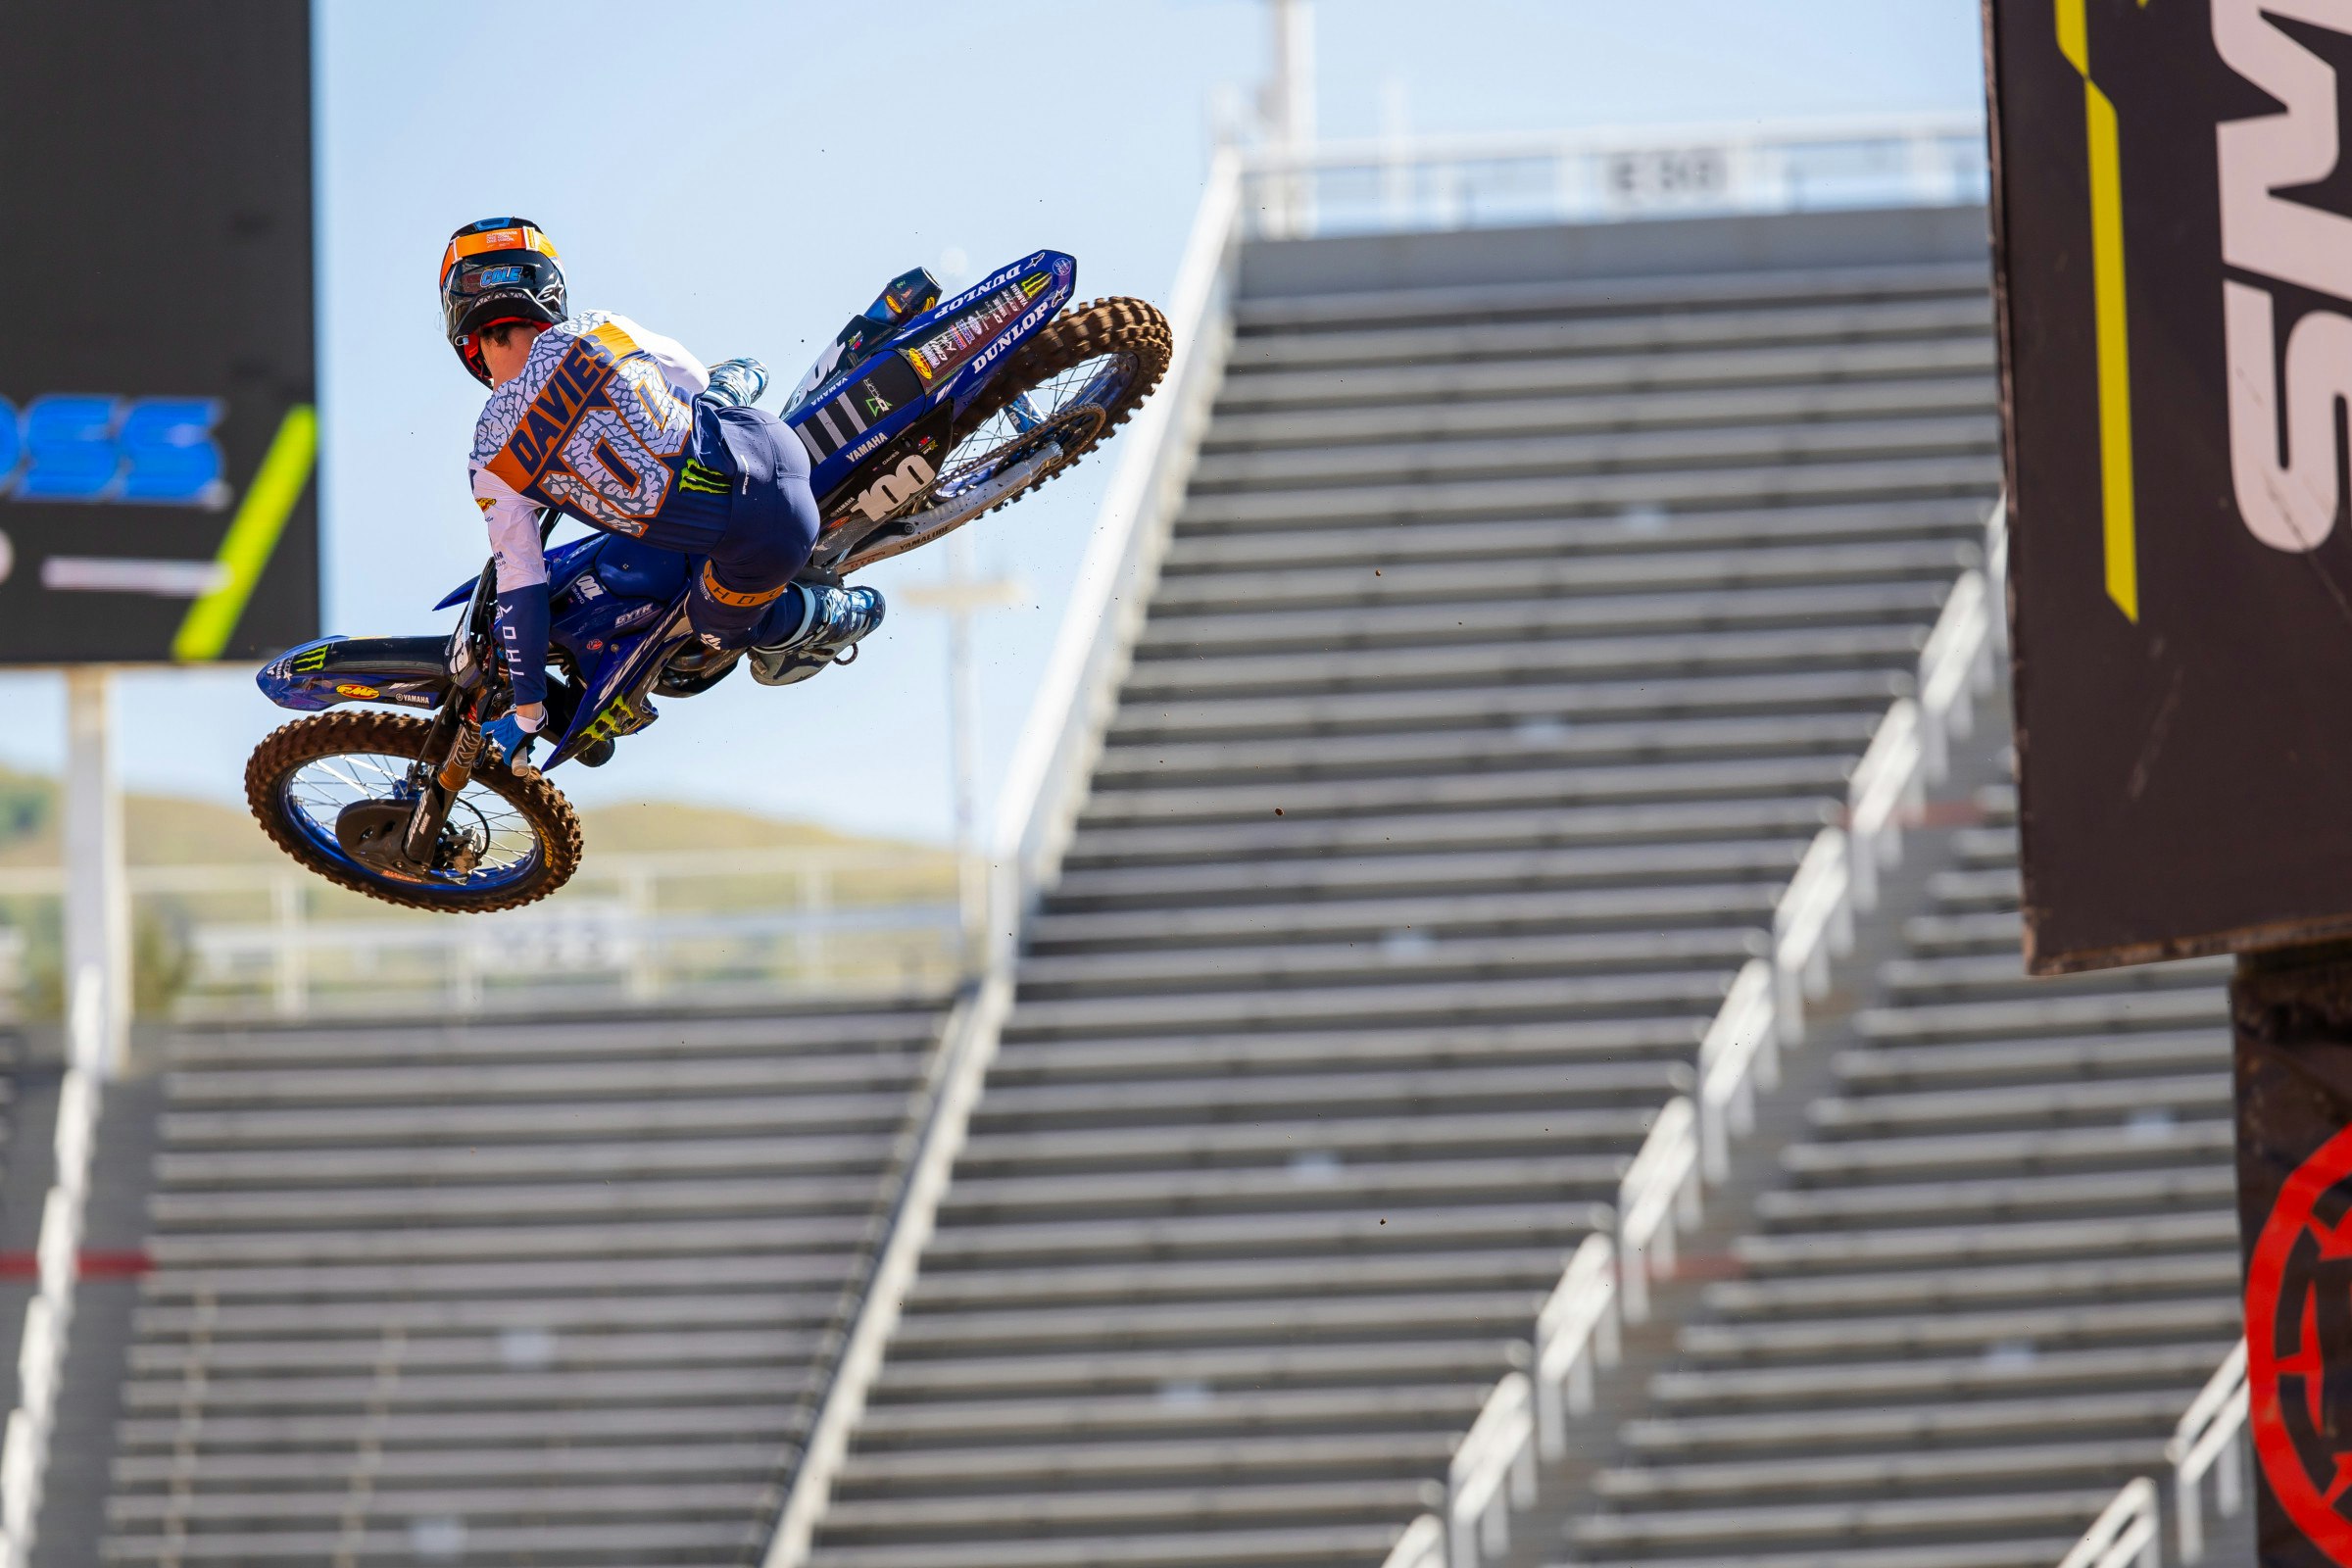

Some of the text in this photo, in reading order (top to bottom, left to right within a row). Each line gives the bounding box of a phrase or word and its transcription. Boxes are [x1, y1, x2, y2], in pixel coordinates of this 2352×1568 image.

[480, 267, 523, 287] COLE
[934, 265, 1021, 319] DUNLOP
[1009, 282, 1029, 308] YAMAHA
[972, 301, 1049, 374] DUNLOP
[508, 334, 614, 475] DAVIES
[810, 377, 849, 406] YAMAHA
[537, 357, 693, 538] 100
[846, 432, 888, 463] YAMAHA
[850, 454, 936, 522] 100
[835, 497, 856, 514] YAMAHA
[900, 523, 951, 551] YAMALUBE
[576, 575, 604, 601] 100
[614, 603, 654, 628] GYTR
[337, 684, 380, 700] FMF
[403, 694, 429, 705] YAMAHA
